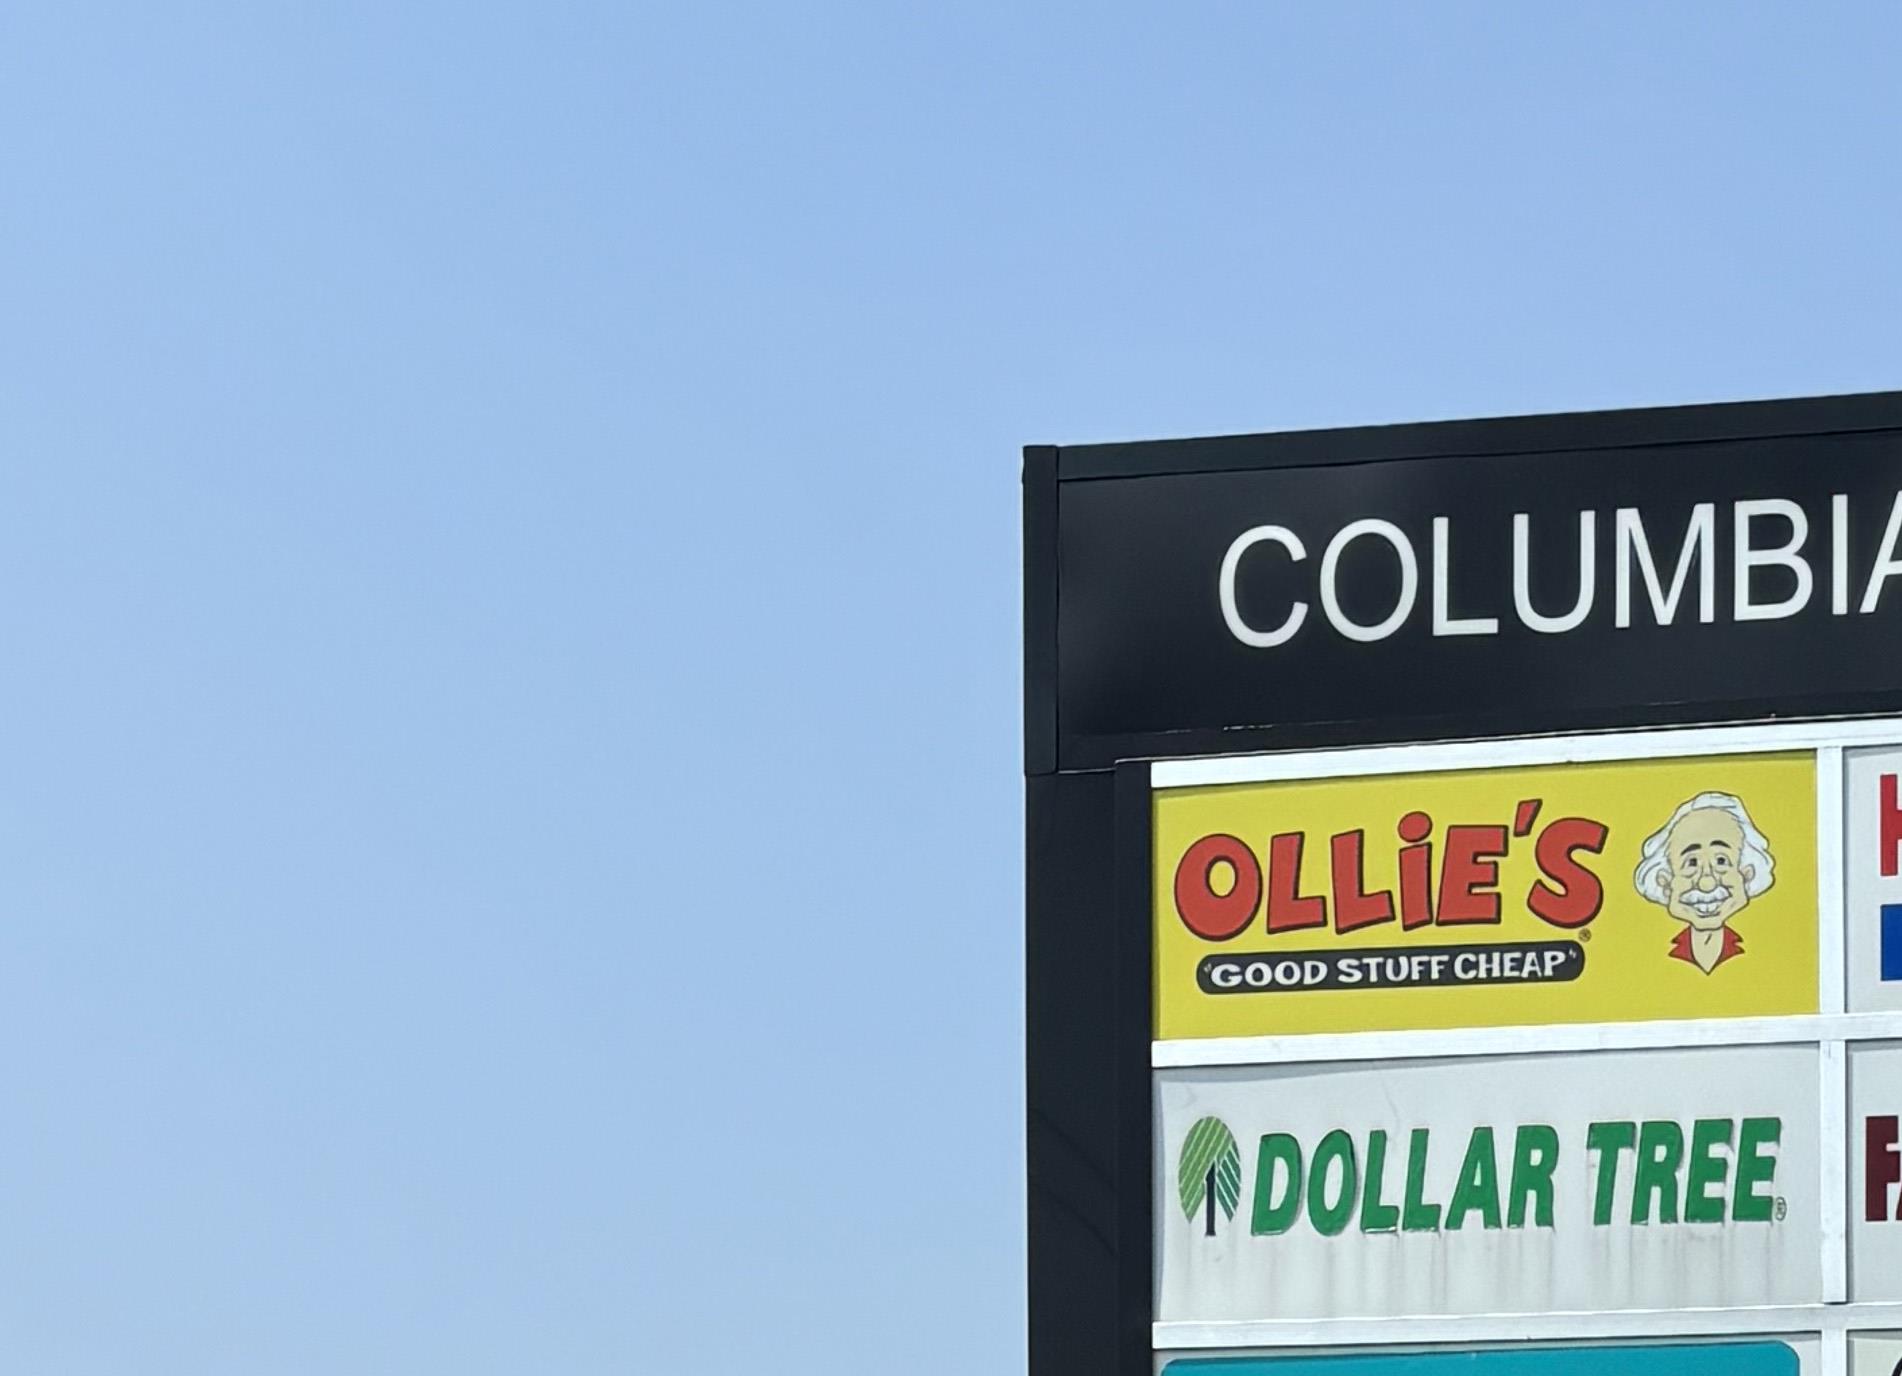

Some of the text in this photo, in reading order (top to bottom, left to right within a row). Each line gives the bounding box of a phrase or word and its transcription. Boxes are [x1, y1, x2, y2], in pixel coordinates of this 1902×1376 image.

[1336, 954, 1450, 984] STUFF
[1250, 1116, 1782, 1237] DOLLAR TREE
